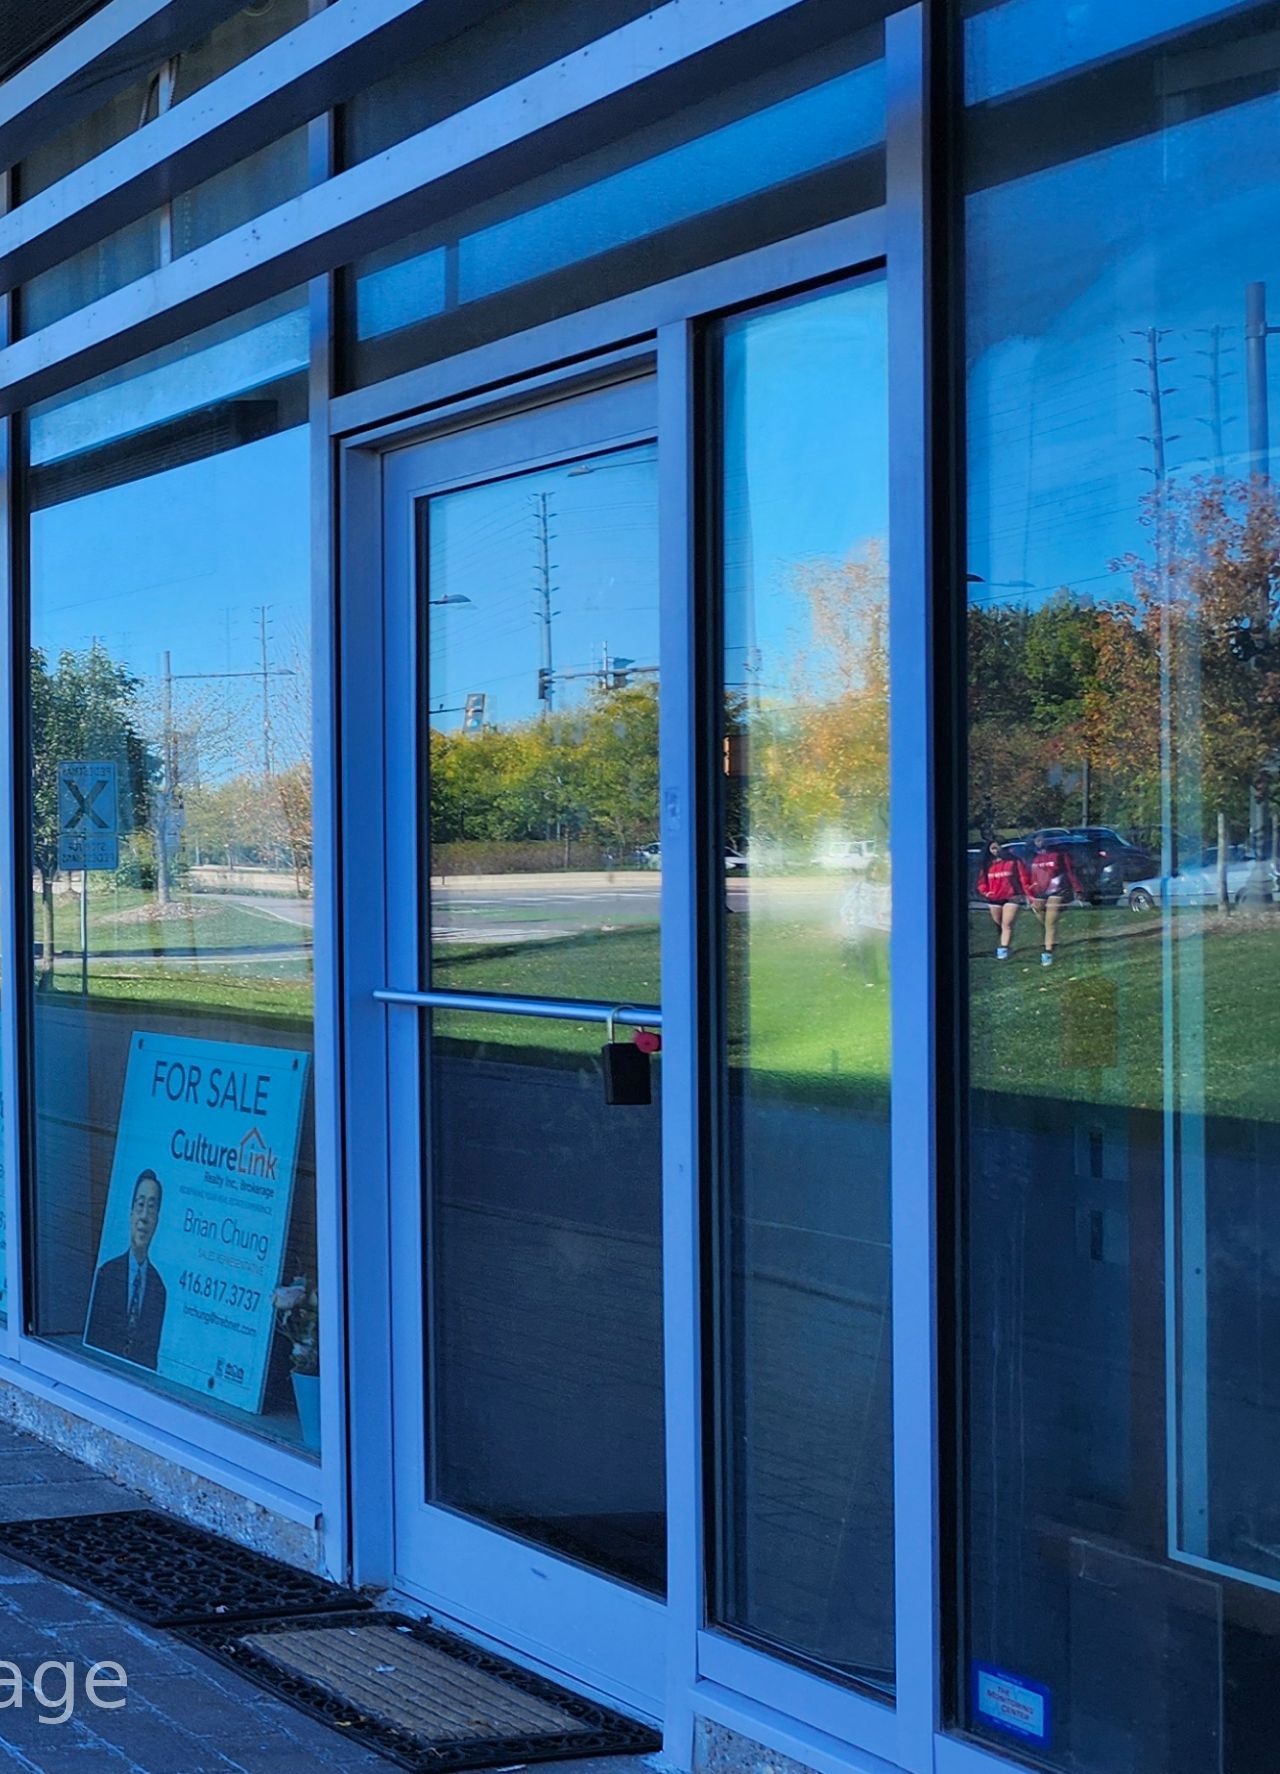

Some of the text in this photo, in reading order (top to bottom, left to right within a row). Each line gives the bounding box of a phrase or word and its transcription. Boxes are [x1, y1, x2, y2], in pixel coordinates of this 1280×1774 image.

[151, 1060, 271, 1116] FOR SALE
[170, 1127, 278, 1181] CultureLink
[184, 1208, 269, 1262] Brian Chung
[179, 1269, 261, 1314] 416.817.3737
